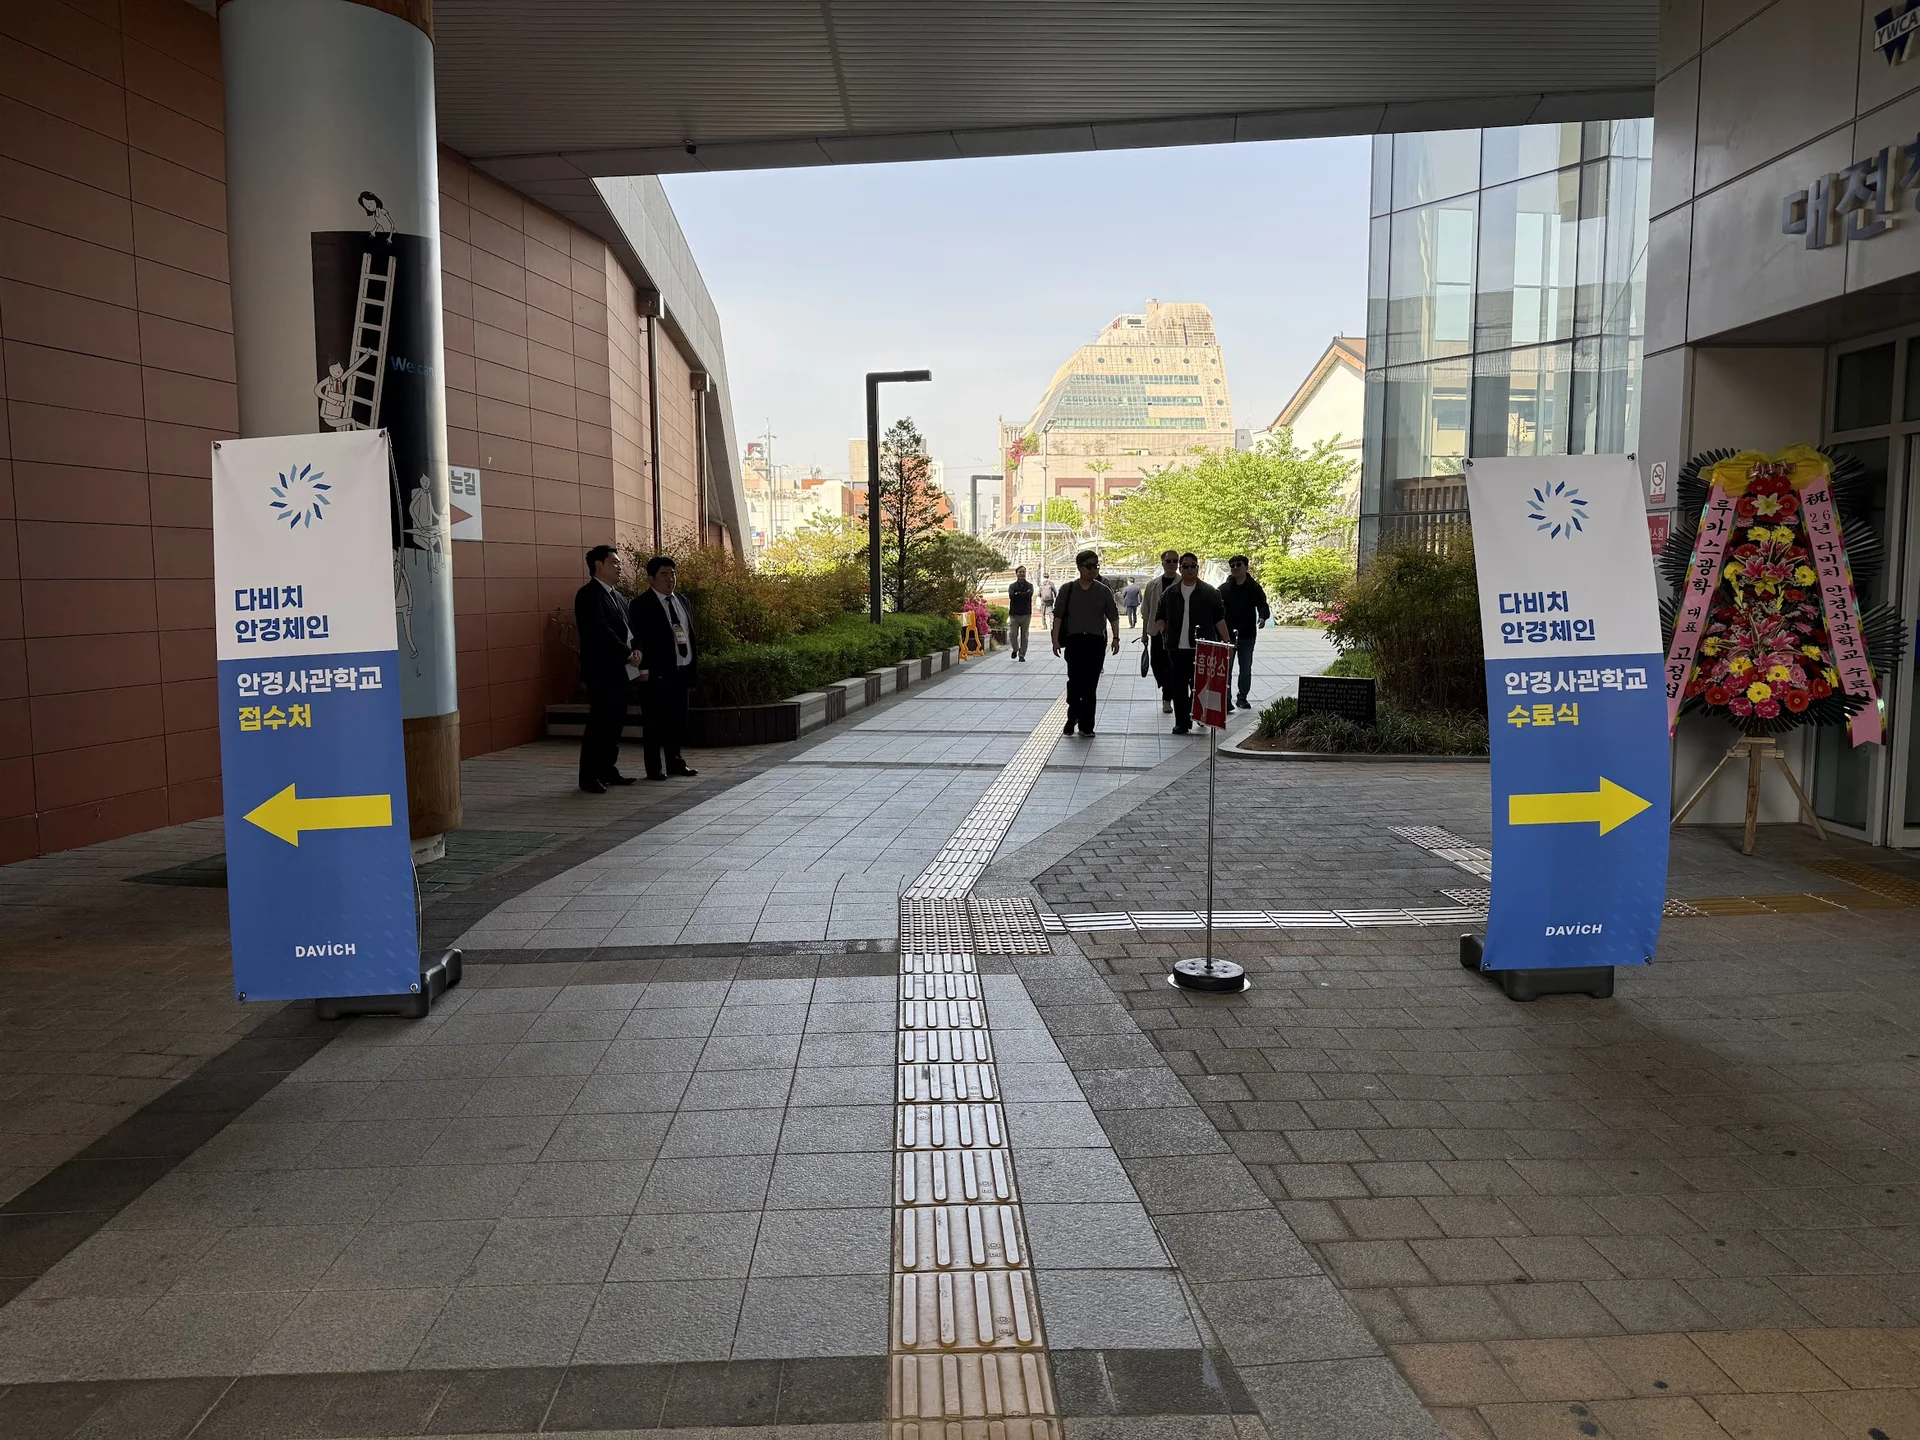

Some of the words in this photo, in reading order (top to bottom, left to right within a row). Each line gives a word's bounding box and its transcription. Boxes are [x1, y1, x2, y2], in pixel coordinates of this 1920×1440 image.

[1877, 11, 1918, 45] YWCA
[390, 355, 415, 373] We
[448, 470, 476, 496] 는길
[1804, 490, 1829, 506] 祝
[1692, 499, 1733, 596] 루카스광학
[1815, 541, 1839, 578] 다비치
[235, 585, 303, 611] 다비치
[1499, 590, 1569, 615] 다비치
[235, 615, 329, 643] 안경체인
[1501, 619, 1595, 644] 안경체인
[1681, 606, 1701, 633] 대표
[1825, 584, 1864, 661] 안경사관학교
[237, 666, 383, 697] 안경사관학교
[1505, 668, 1648, 695] 안경사관학교
[238, 703, 312, 732] 접수처
[1507, 702, 1579, 728] 수료식
